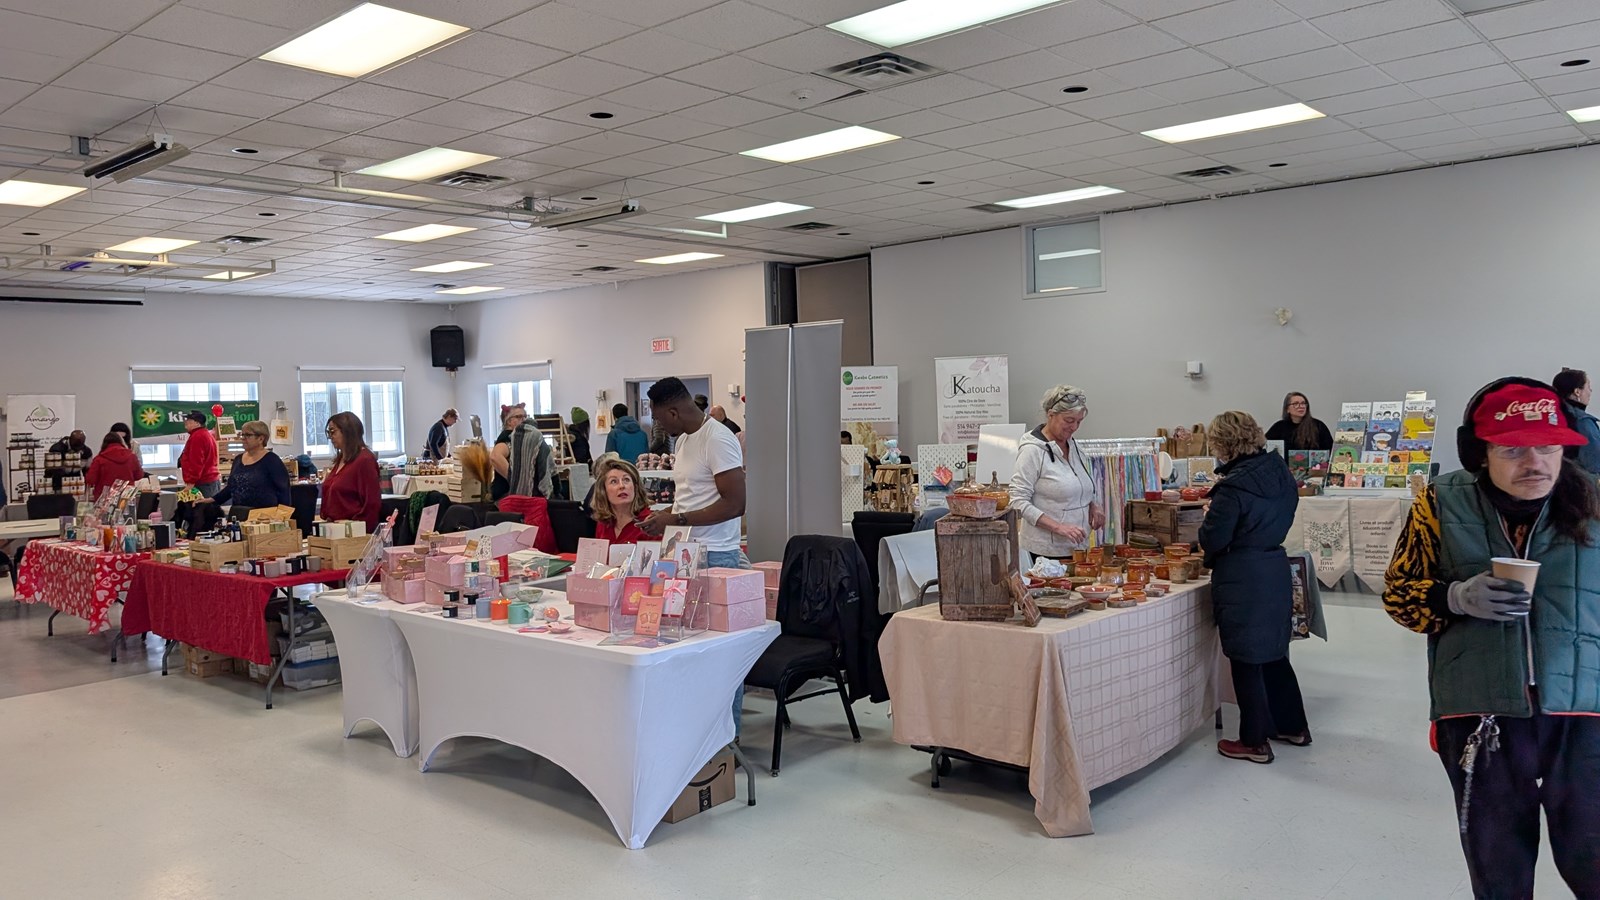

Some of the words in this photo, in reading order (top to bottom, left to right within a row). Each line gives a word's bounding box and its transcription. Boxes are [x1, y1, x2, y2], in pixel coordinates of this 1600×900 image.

[653, 340, 669, 351] SORTIE
[953, 375, 1001, 394] Katoucha
[1506, 398, 1556, 417] Coca-Cola
[25, 415, 60, 425] Amango
